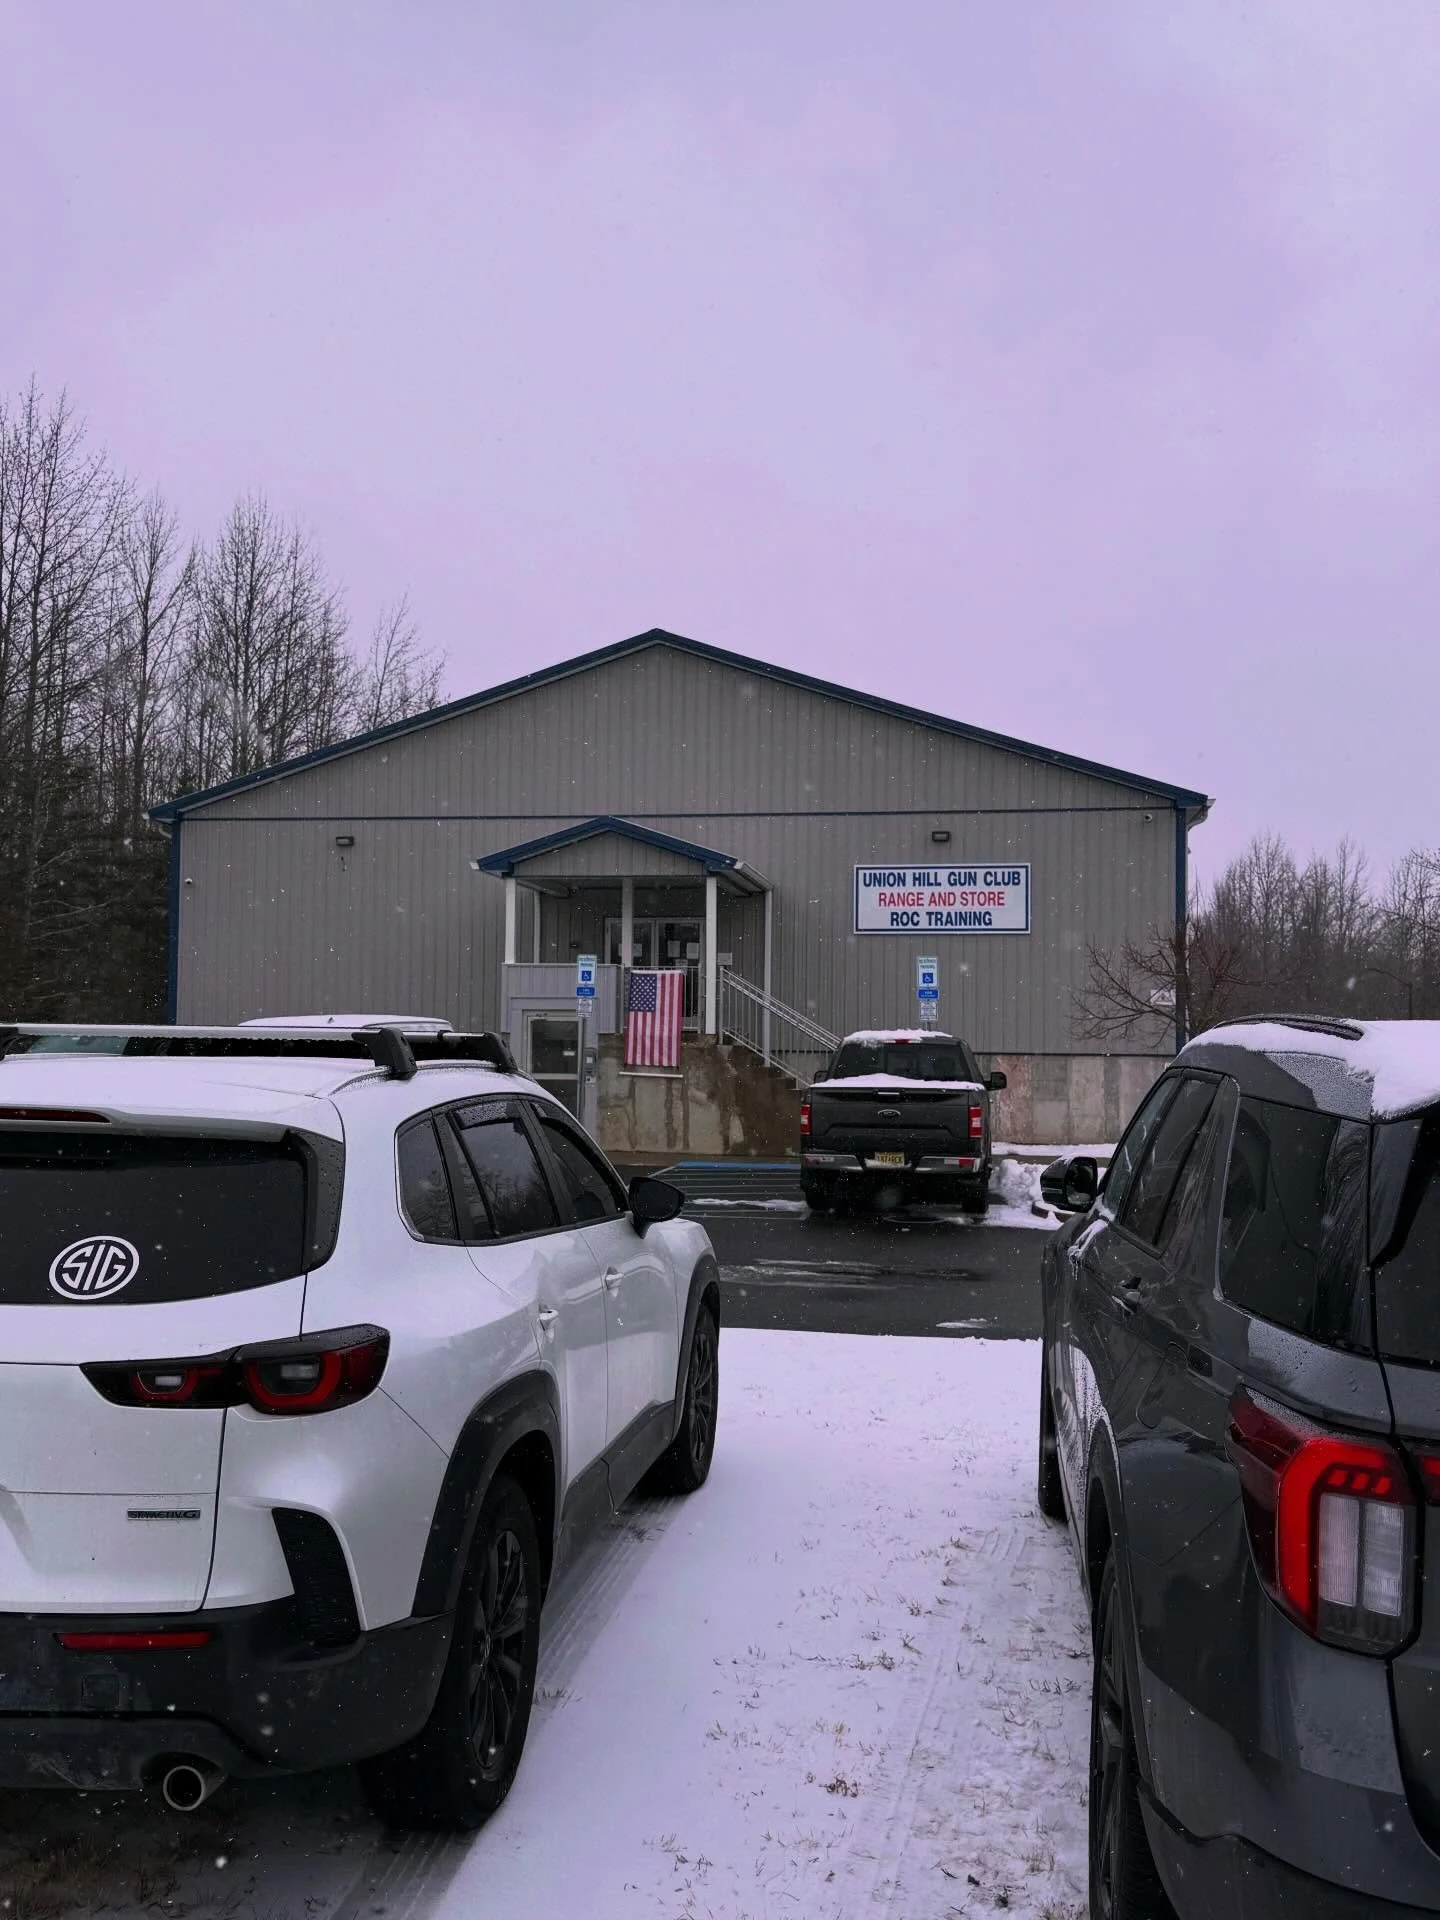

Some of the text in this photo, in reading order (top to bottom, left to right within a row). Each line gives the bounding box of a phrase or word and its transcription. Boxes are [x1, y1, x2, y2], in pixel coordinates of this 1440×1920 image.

[863, 871, 1021, 887] UNION HILL GUN CLUB
[878, 891, 1005, 907] RANGE AND STORE
[890, 911, 993, 926] ROC TRAINING
[62, 1244, 127, 1291] SIG
